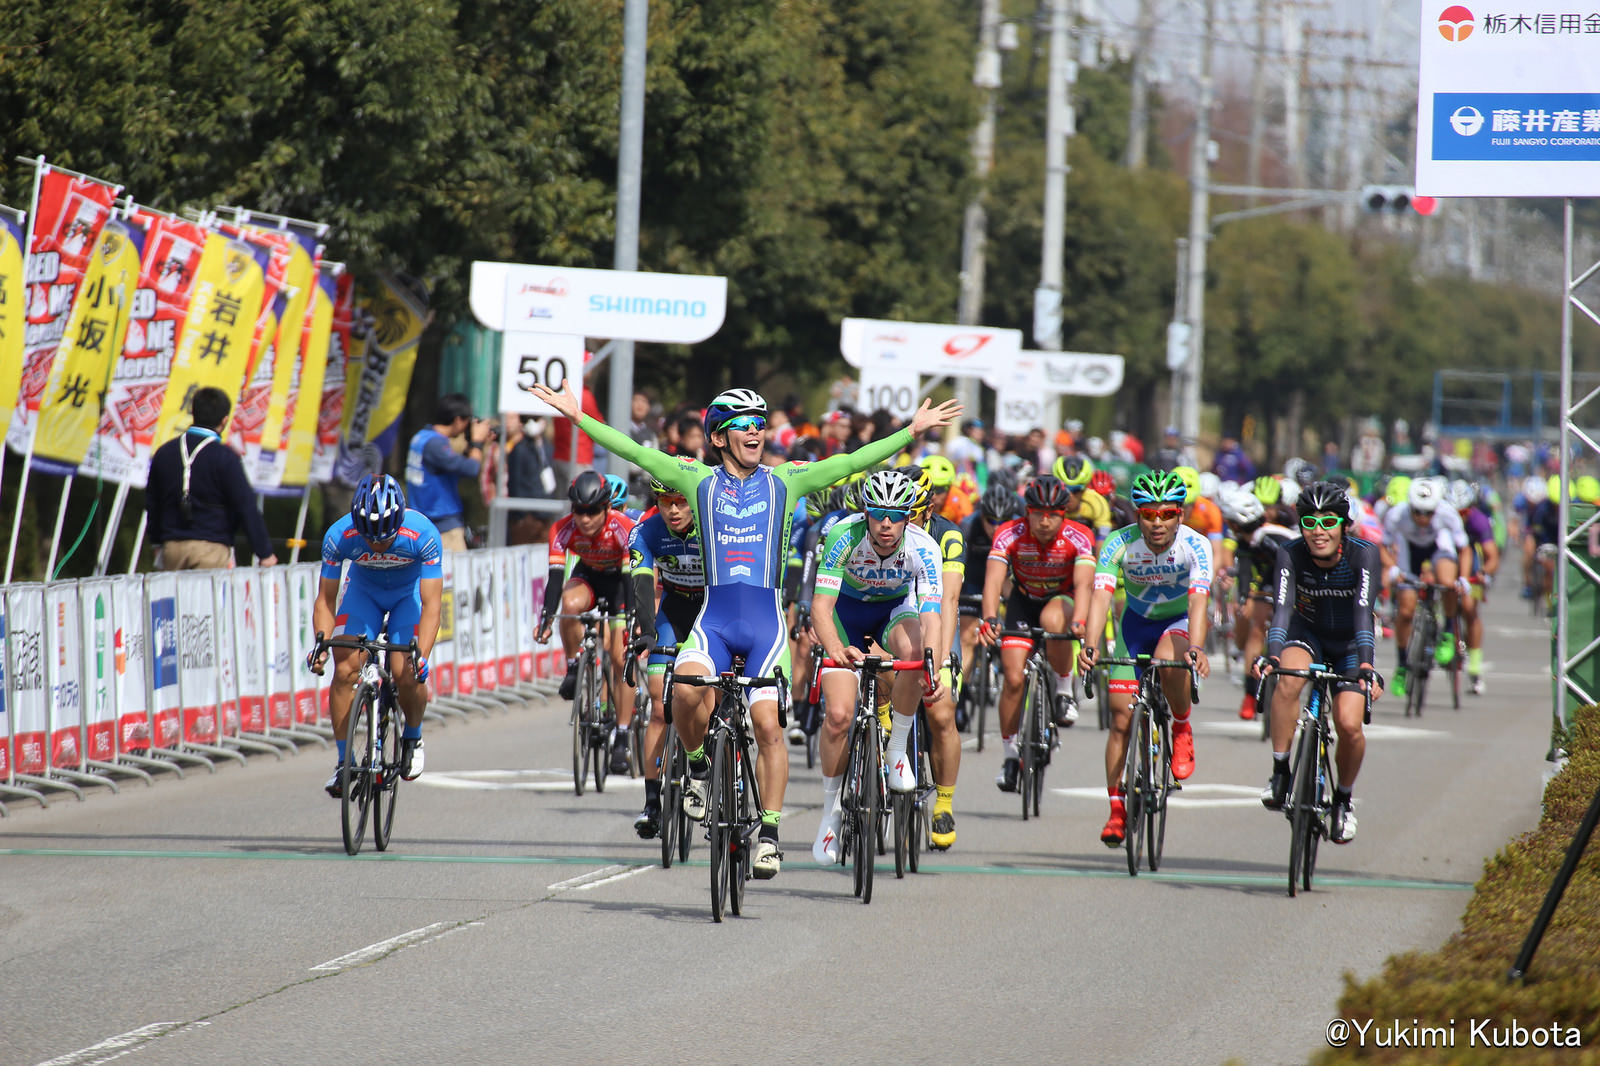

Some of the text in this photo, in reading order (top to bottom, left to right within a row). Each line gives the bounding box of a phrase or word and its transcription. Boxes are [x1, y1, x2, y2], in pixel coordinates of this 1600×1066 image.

[1512, 138, 1548, 146] SANGYO
[589, 294, 706, 318] SHIMANO
[57, 275, 115, 408] 小坂光
[517, 355, 568, 392] 50
[867, 385, 914, 413] 100
[787, 467, 809, 477] Igname
[717, 531, 764, 545] Igname
[724, 524, 757, 535] Legarsi
[825, 531, 854, 570] MATRIX
[1099, 530, 1132, 568] MATRIX
[1184, 535, 1210, 572] MATRIX
[848, 566, 913, 580] MATRIX
[916, 547, 939, 586] MATRIX
[1128, 564, 1186, 576] MATRIX
